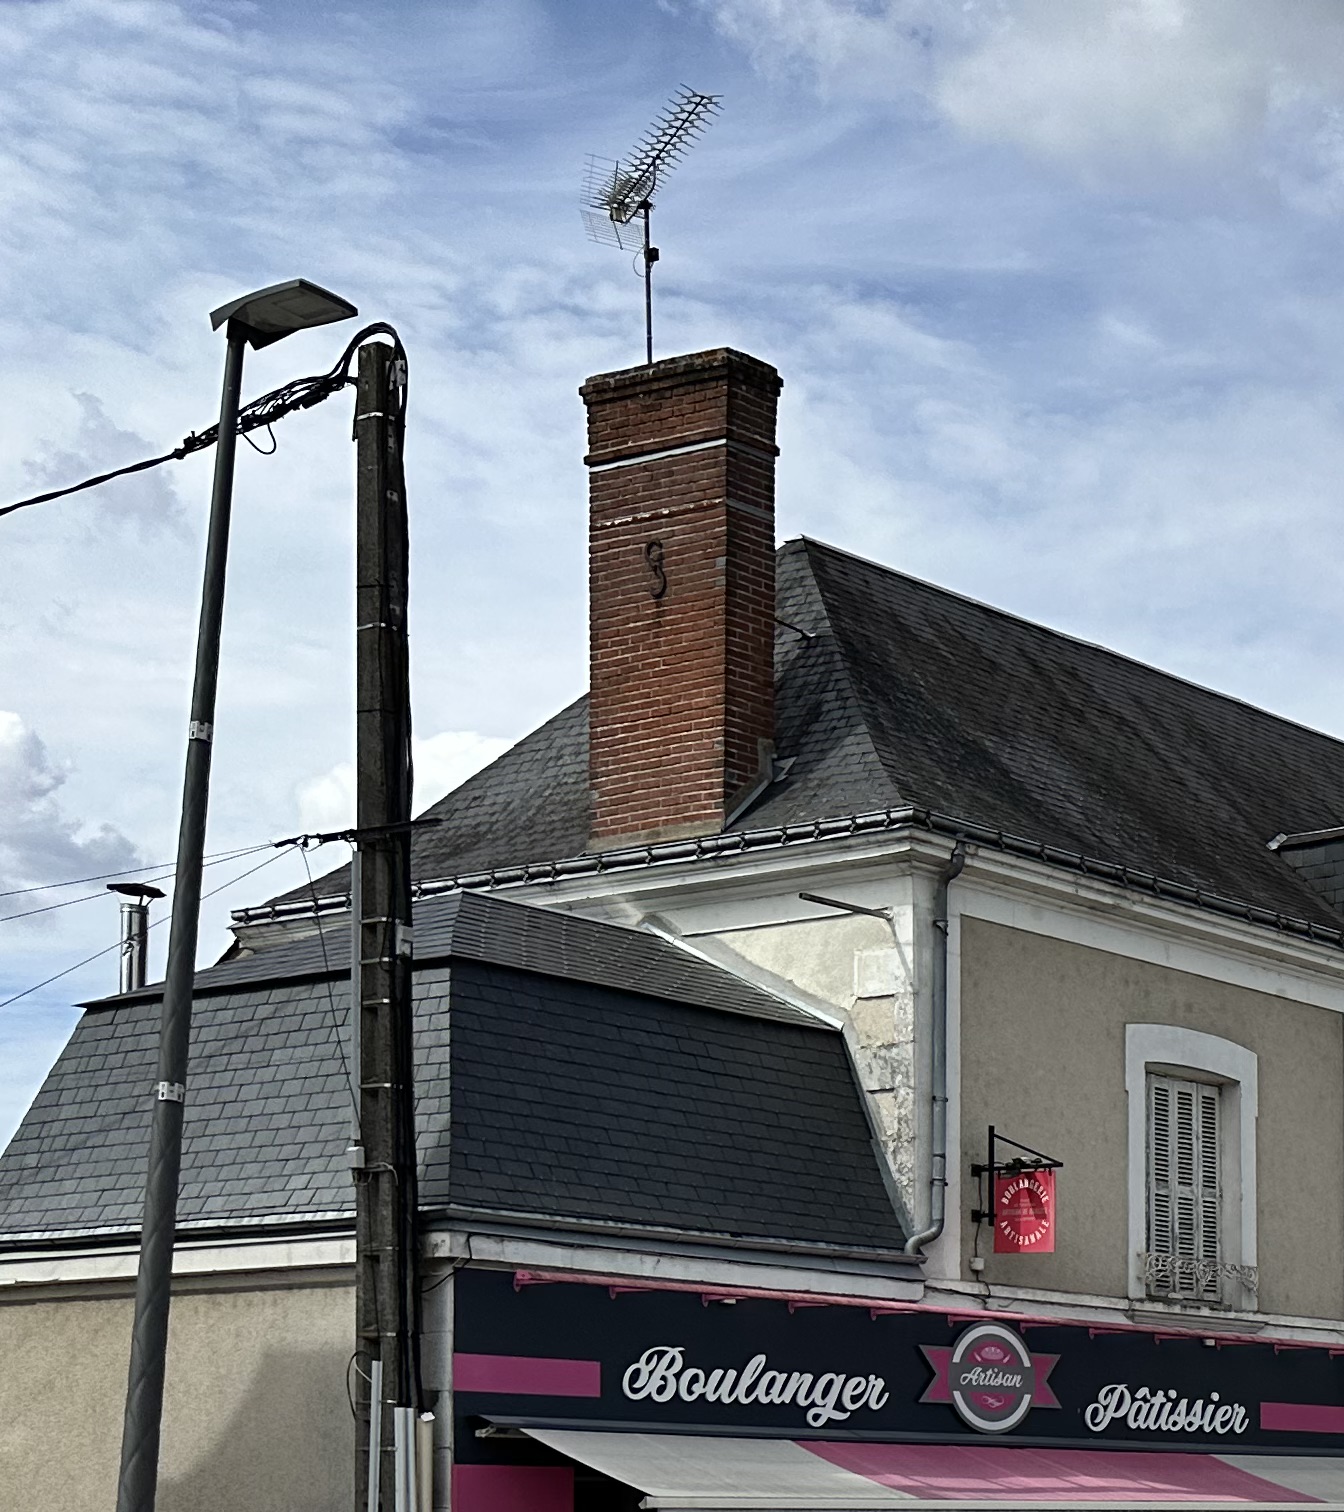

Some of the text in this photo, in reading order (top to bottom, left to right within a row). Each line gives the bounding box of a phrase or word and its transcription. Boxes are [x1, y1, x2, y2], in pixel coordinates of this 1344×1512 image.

[1000, 1219, 1050, 1246] ARTISANALE
[622, 1346, 889, 1428] Boulanger
[960, 1366, 1023, 1388] Artisan
[1085, 1384, 1249, 1434] Pâtissier
